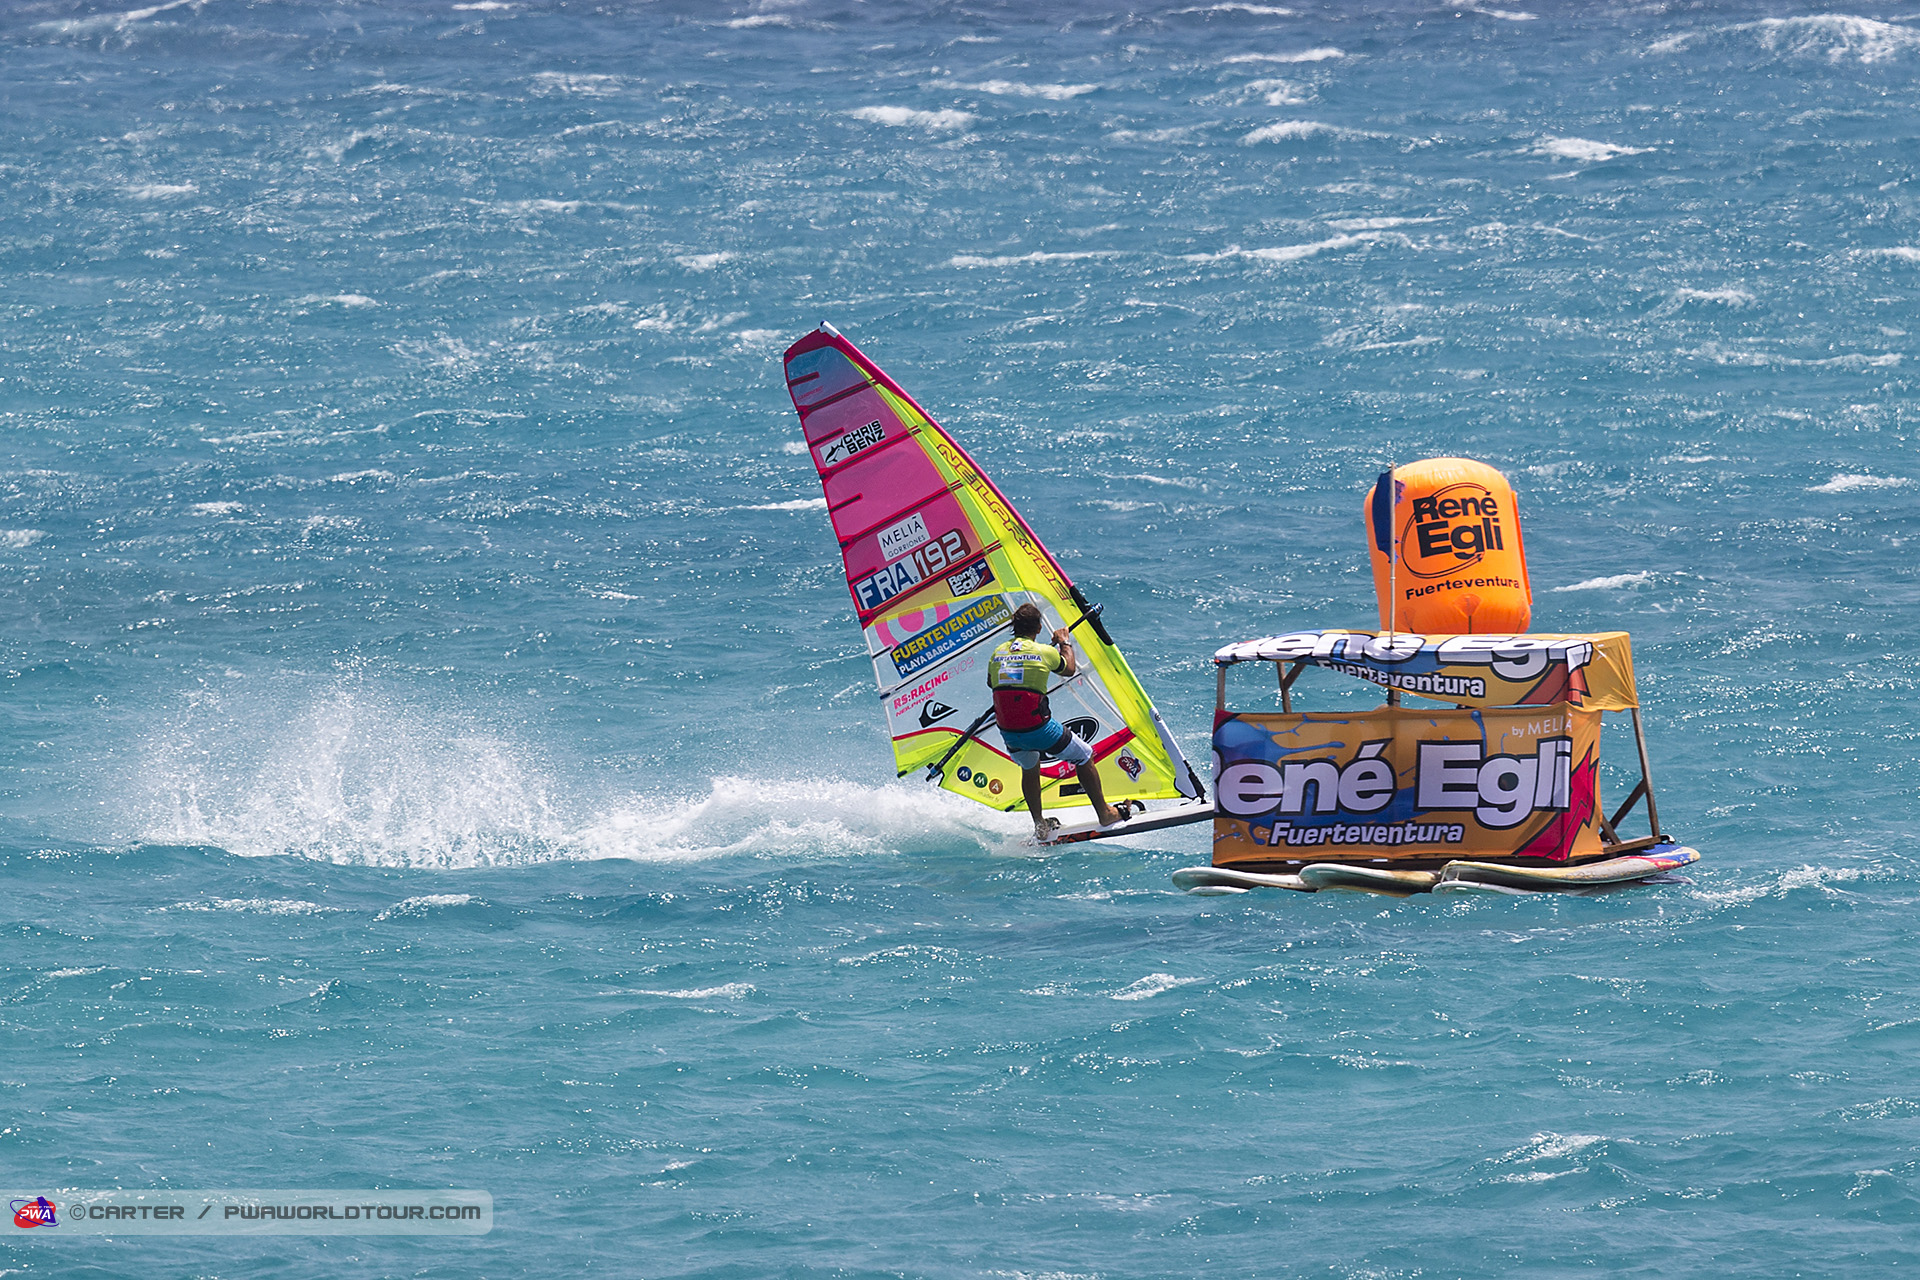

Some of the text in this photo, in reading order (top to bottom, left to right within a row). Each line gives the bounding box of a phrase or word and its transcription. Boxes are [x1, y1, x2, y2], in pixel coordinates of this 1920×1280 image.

[843, 420, 881, 444] CHRIS
[846, 429, 886, 454] BENZ
[1412, 492, 1499, 523] René
[937, 443, 1072, 601] NEILPRYDE
[888, 534, 926, 557] GORRIONES
[1416, 517, 1505, 560] Egli
[855, 531, 967, 610] FRA 192
[947, 566, 978, 585] René
[951, 574, 981, 597] Egli
[1405, 576, 1520, 601] Fuerteventura
[892, 595, 1004, 663] FUERTEVENTURA
[898, 651, 928, 675] PLAYA
[925, 640, 957, 660] BARCA
[960, 608, 1010, 641] SOTAVENTO
[1511, 726, 1524, 738] by
[1213, 739, 1572, 828] ené Egli
[1268, 820, 1465, 846] Fuerteventura
